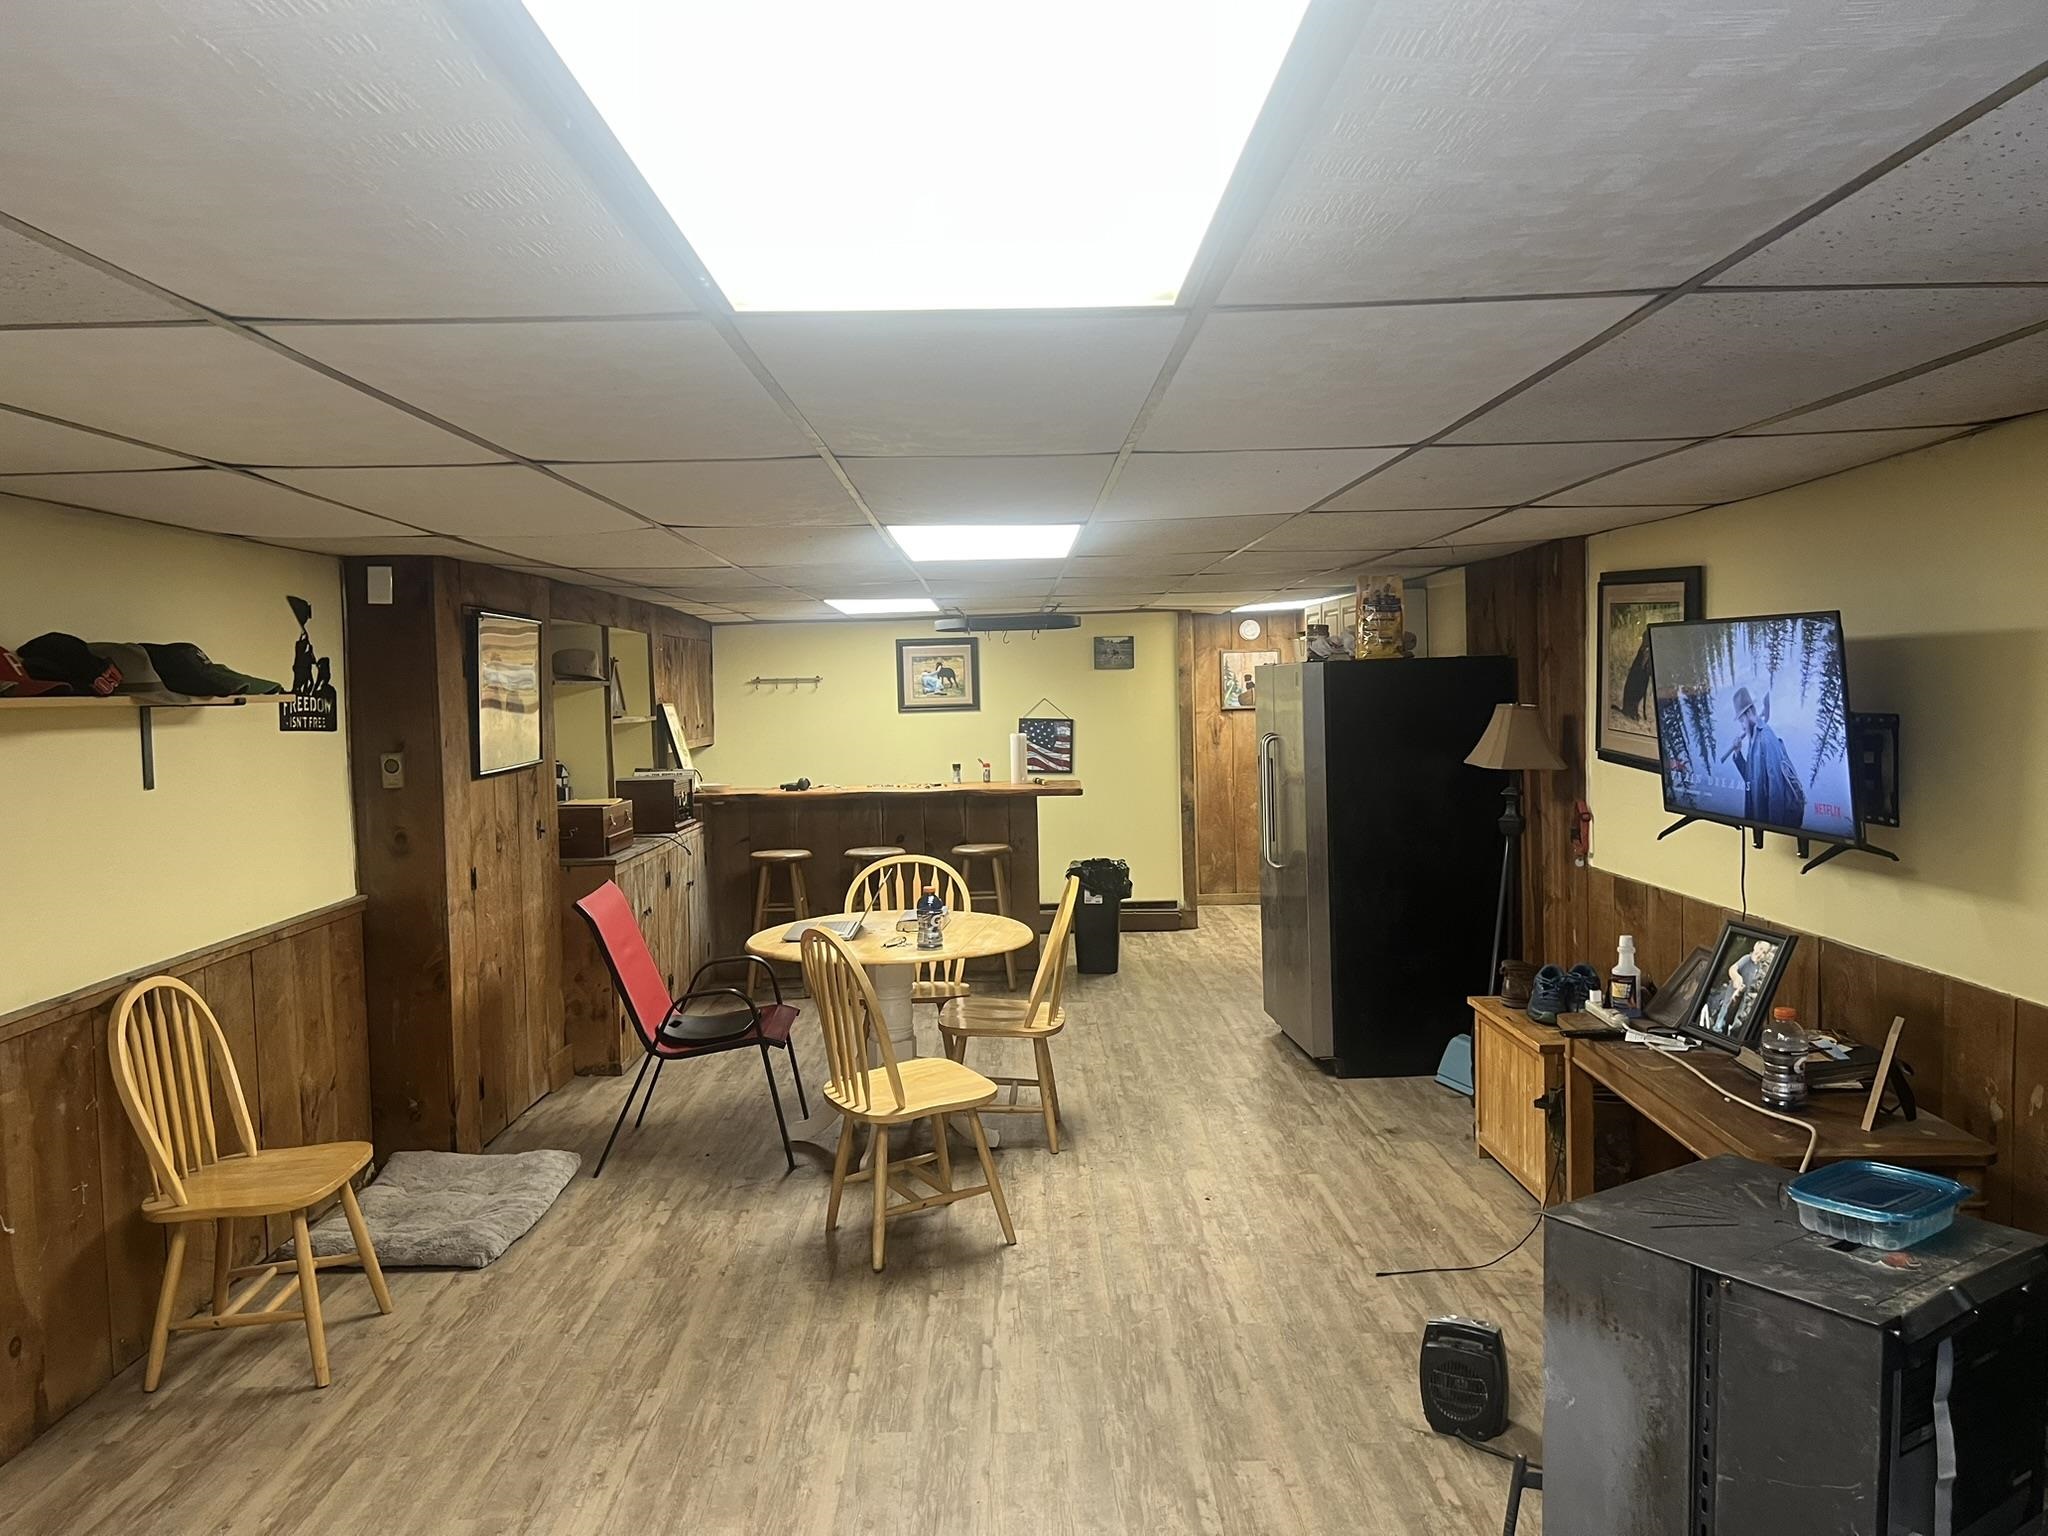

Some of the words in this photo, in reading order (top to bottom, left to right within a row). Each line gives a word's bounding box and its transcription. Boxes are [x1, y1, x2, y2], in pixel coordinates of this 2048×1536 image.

[283, 695, 332, 716] FREEDOM
[309, 716, 326, 728] FREE
[1814, 802, 1841, 817] NETFLIX
